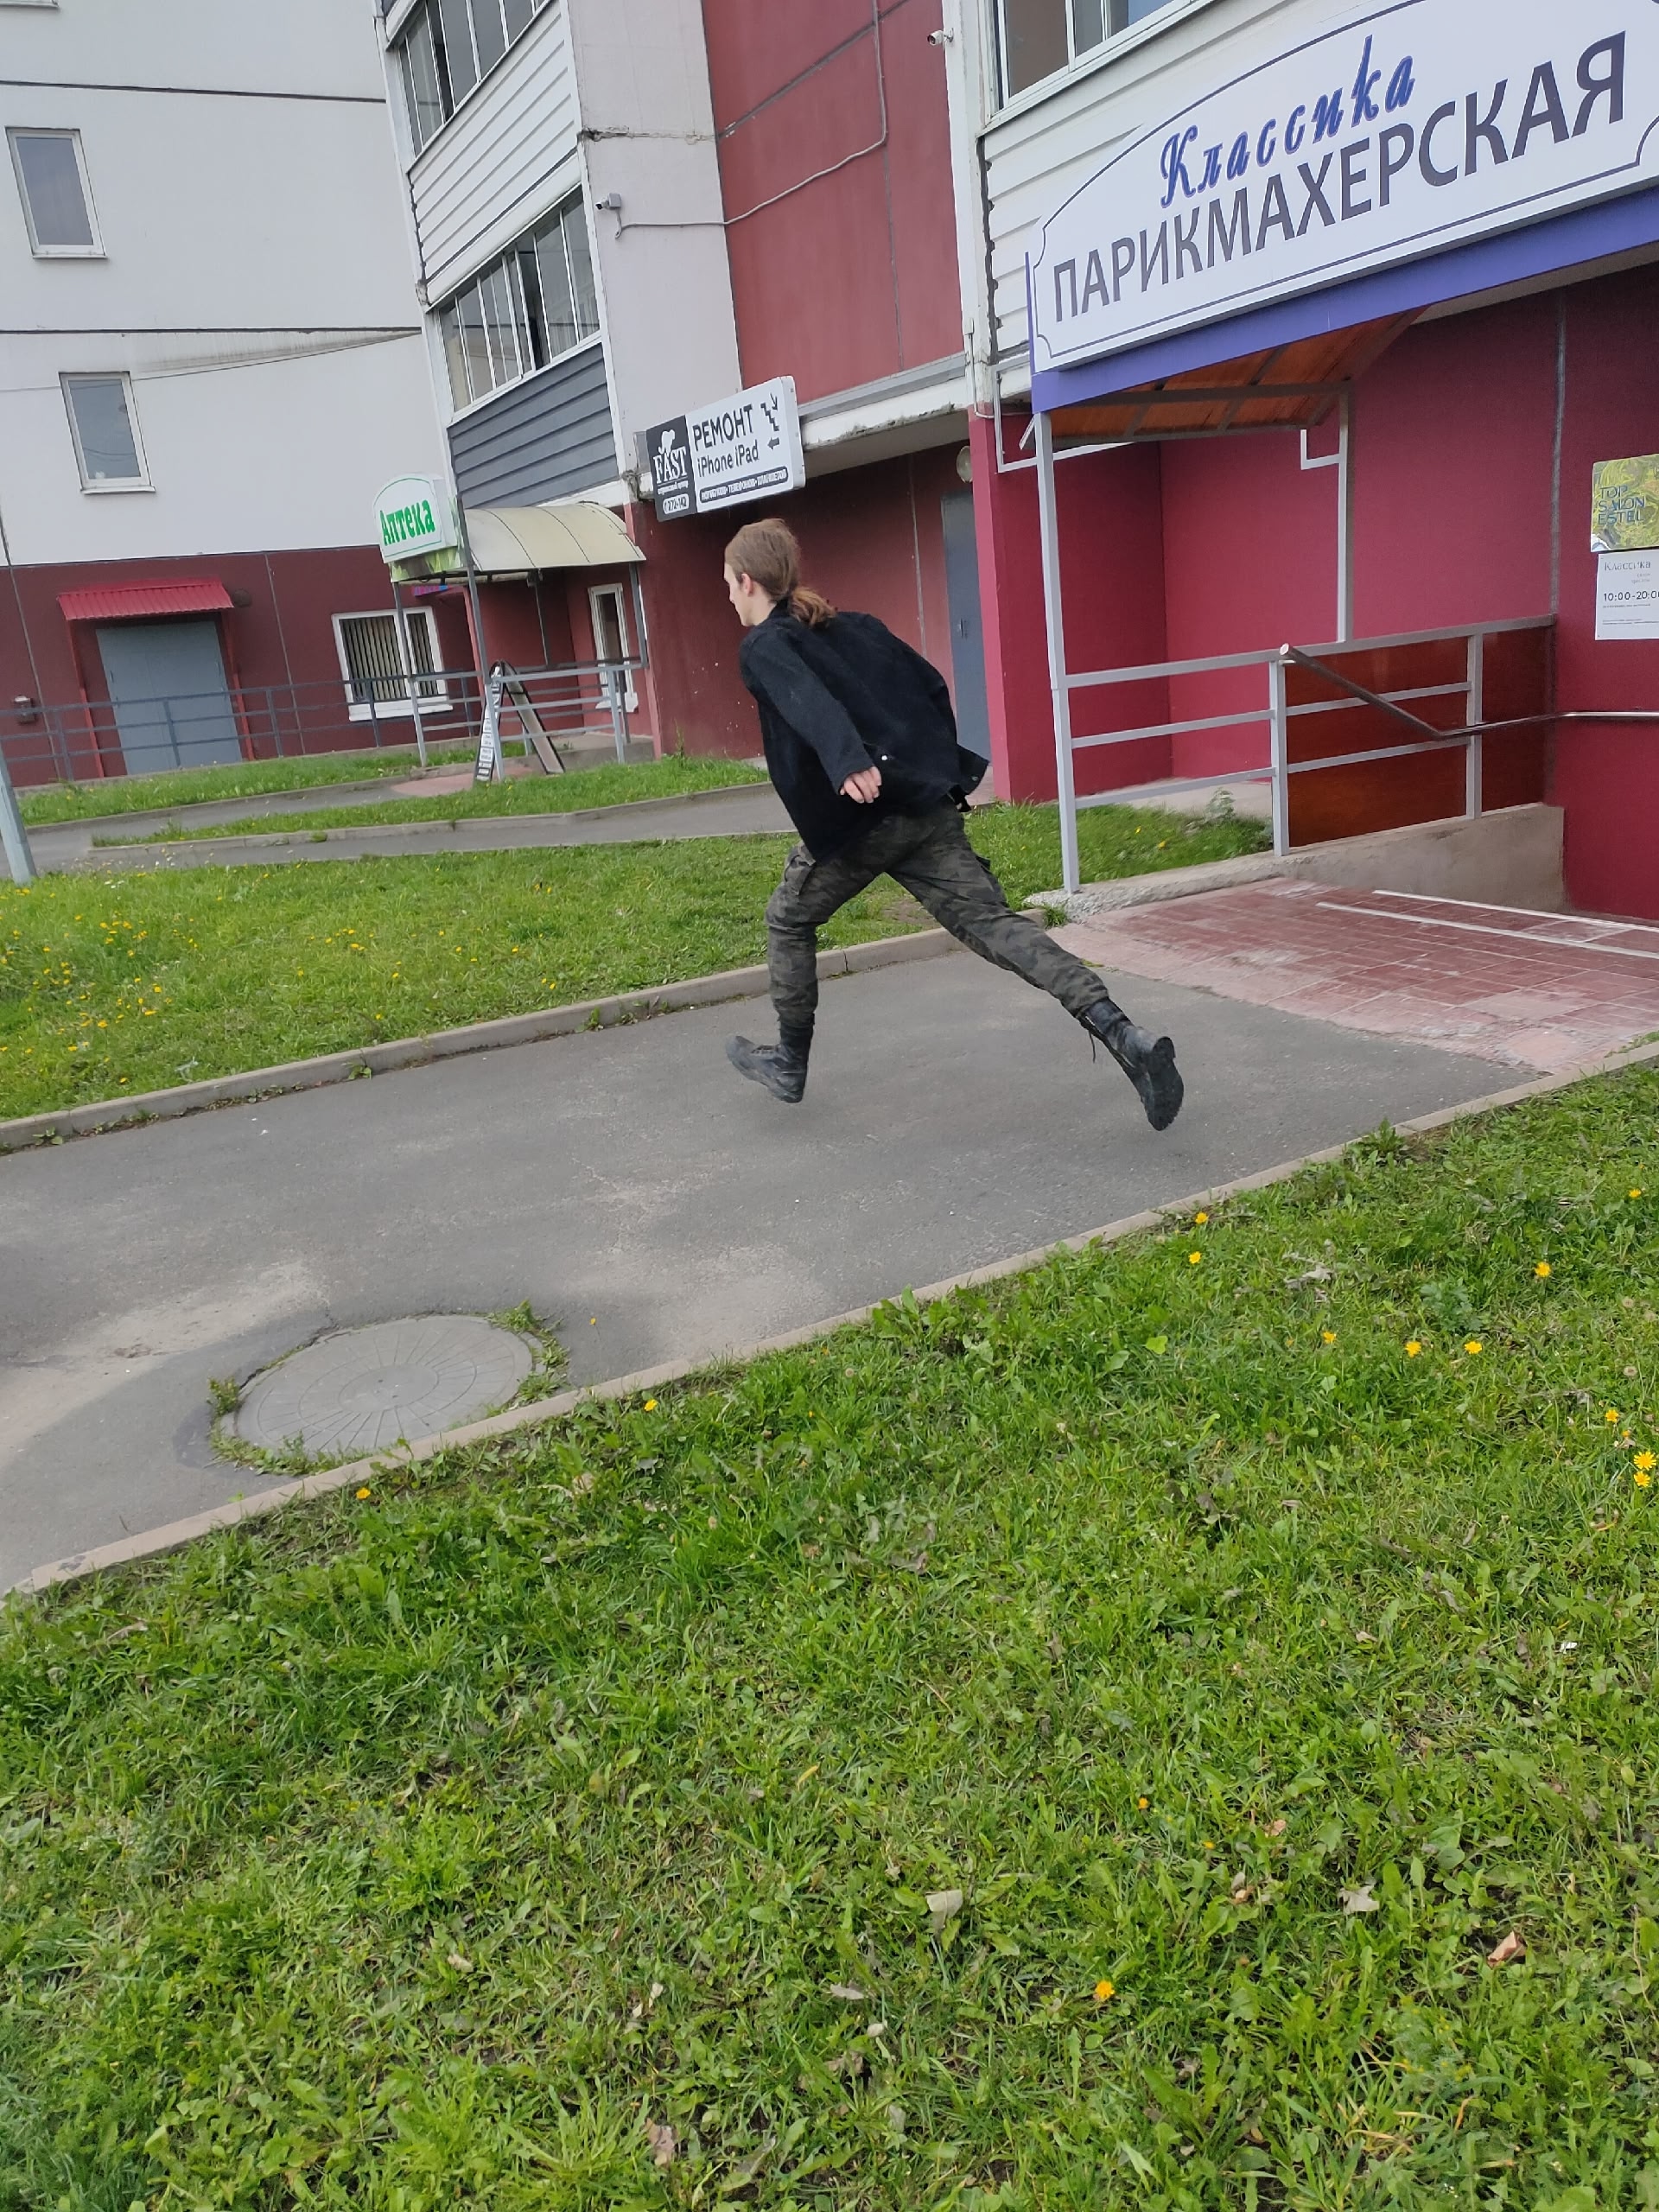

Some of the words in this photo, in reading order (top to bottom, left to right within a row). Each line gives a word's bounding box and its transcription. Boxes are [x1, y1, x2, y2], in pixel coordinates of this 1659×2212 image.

[1159, 35, 1416, 209] Классика
[1052, 31, 1627, 323] ПАРИКМАХЕРСКАЯ
[692, 404, 754, 452] РЕМОНТ
[653, 446, 688, 484] FAST
[697, 451, 734, 478] iPhone
[734, 438, 760, 467] iPad
[1599, 485, 1628, 499] TOP
[379, 499, 436, 546] Аптека
[1599, 509, 1644, 524] ESTEL
[1605, 561, 1651, 571] Классика
[1604, 590, 1659, 601] 10:00-20:0
